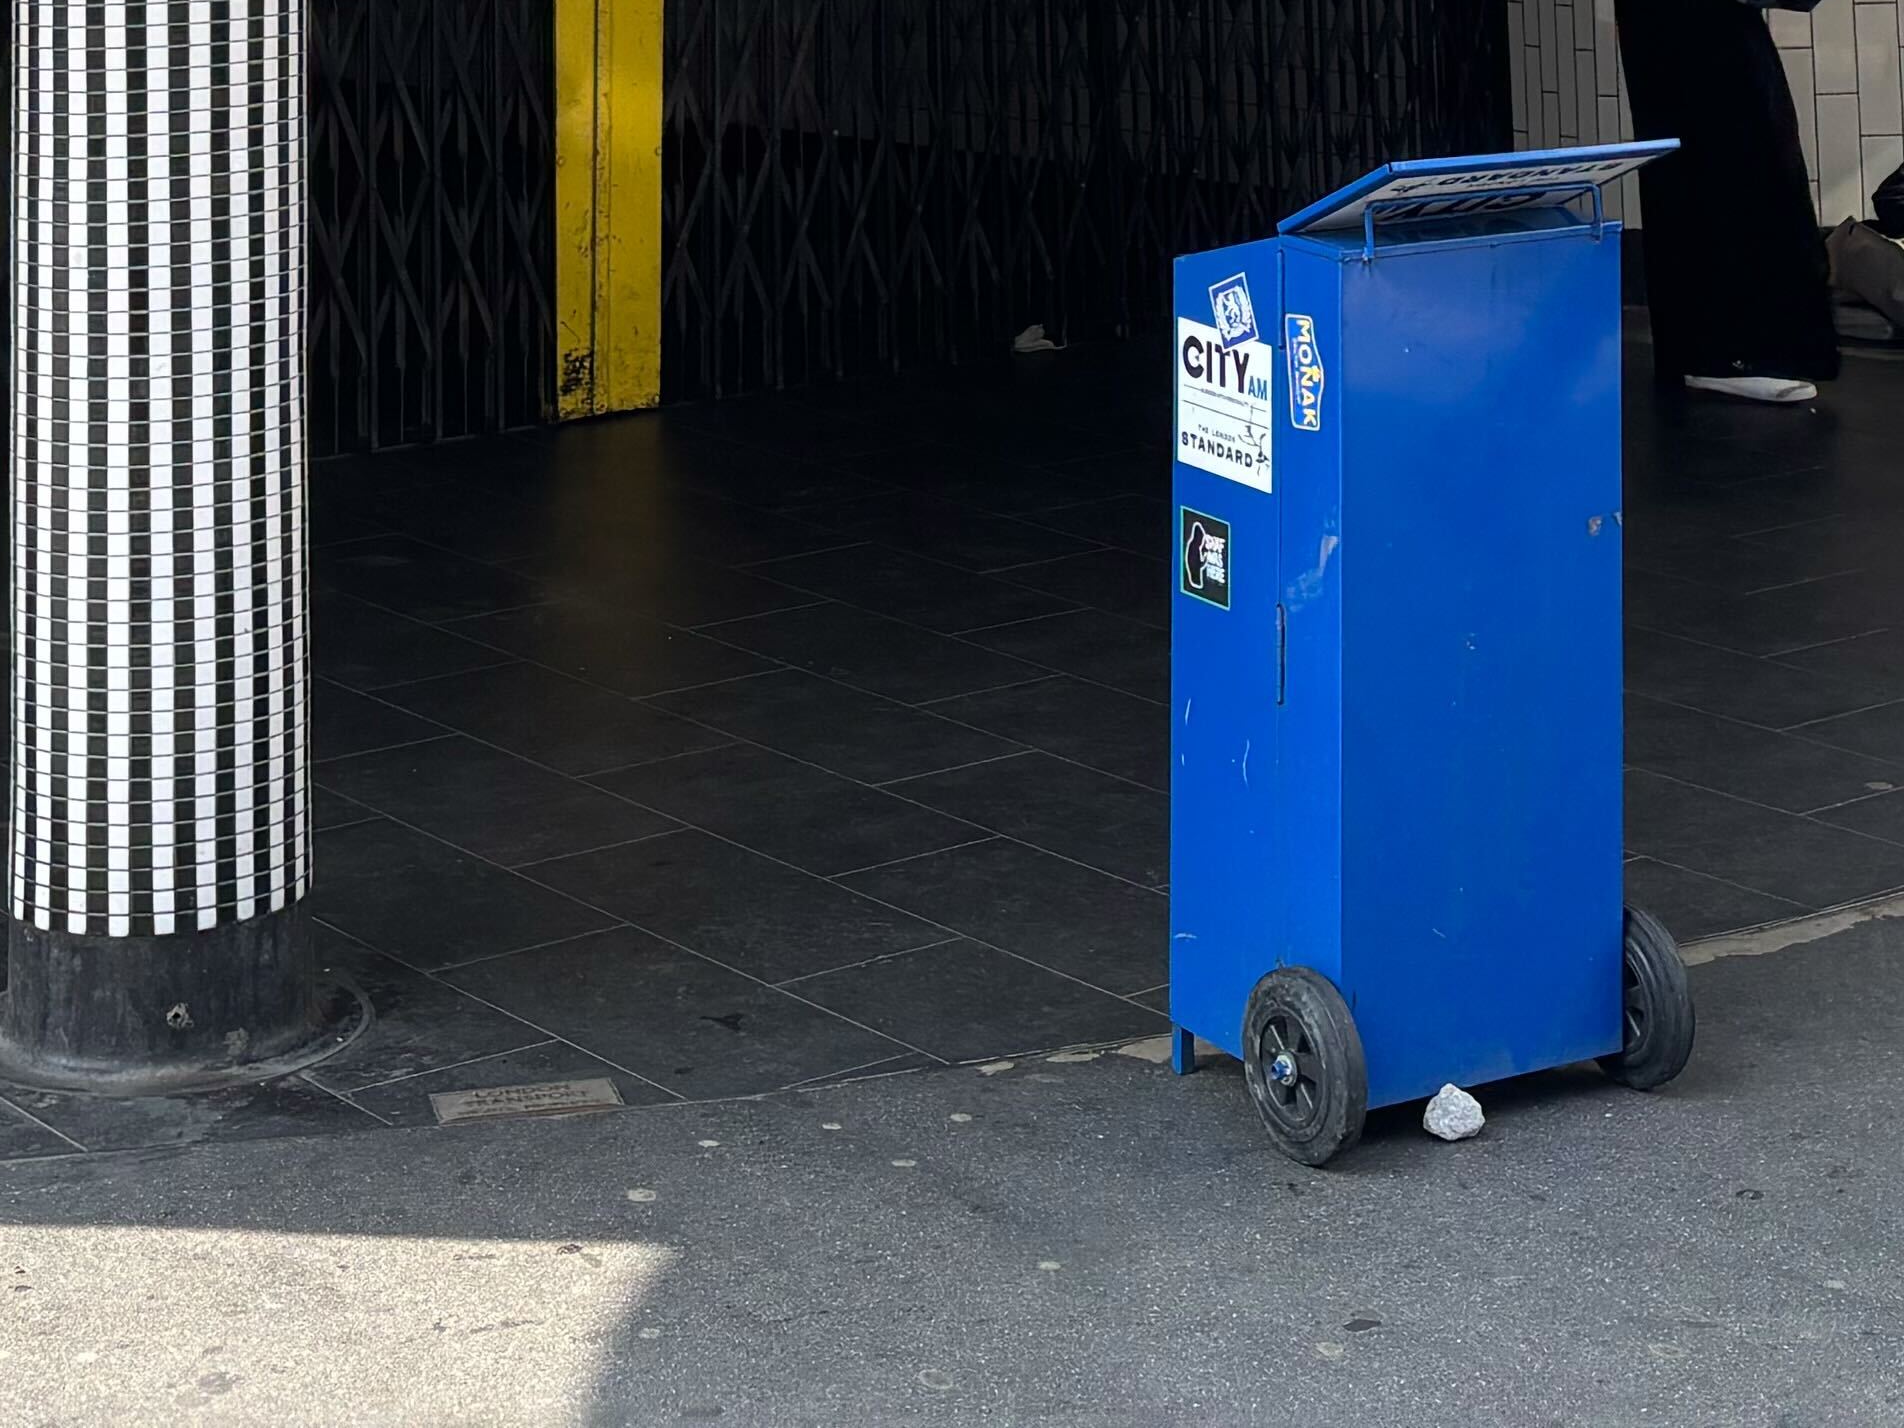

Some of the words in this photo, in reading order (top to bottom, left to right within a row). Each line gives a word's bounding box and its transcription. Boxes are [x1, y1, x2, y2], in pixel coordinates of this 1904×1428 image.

[1183, 335, 1250, 394] CITY
[1248, 375, 1268, 401] AM
[1182, 431, 1253, 468] STANDARD
